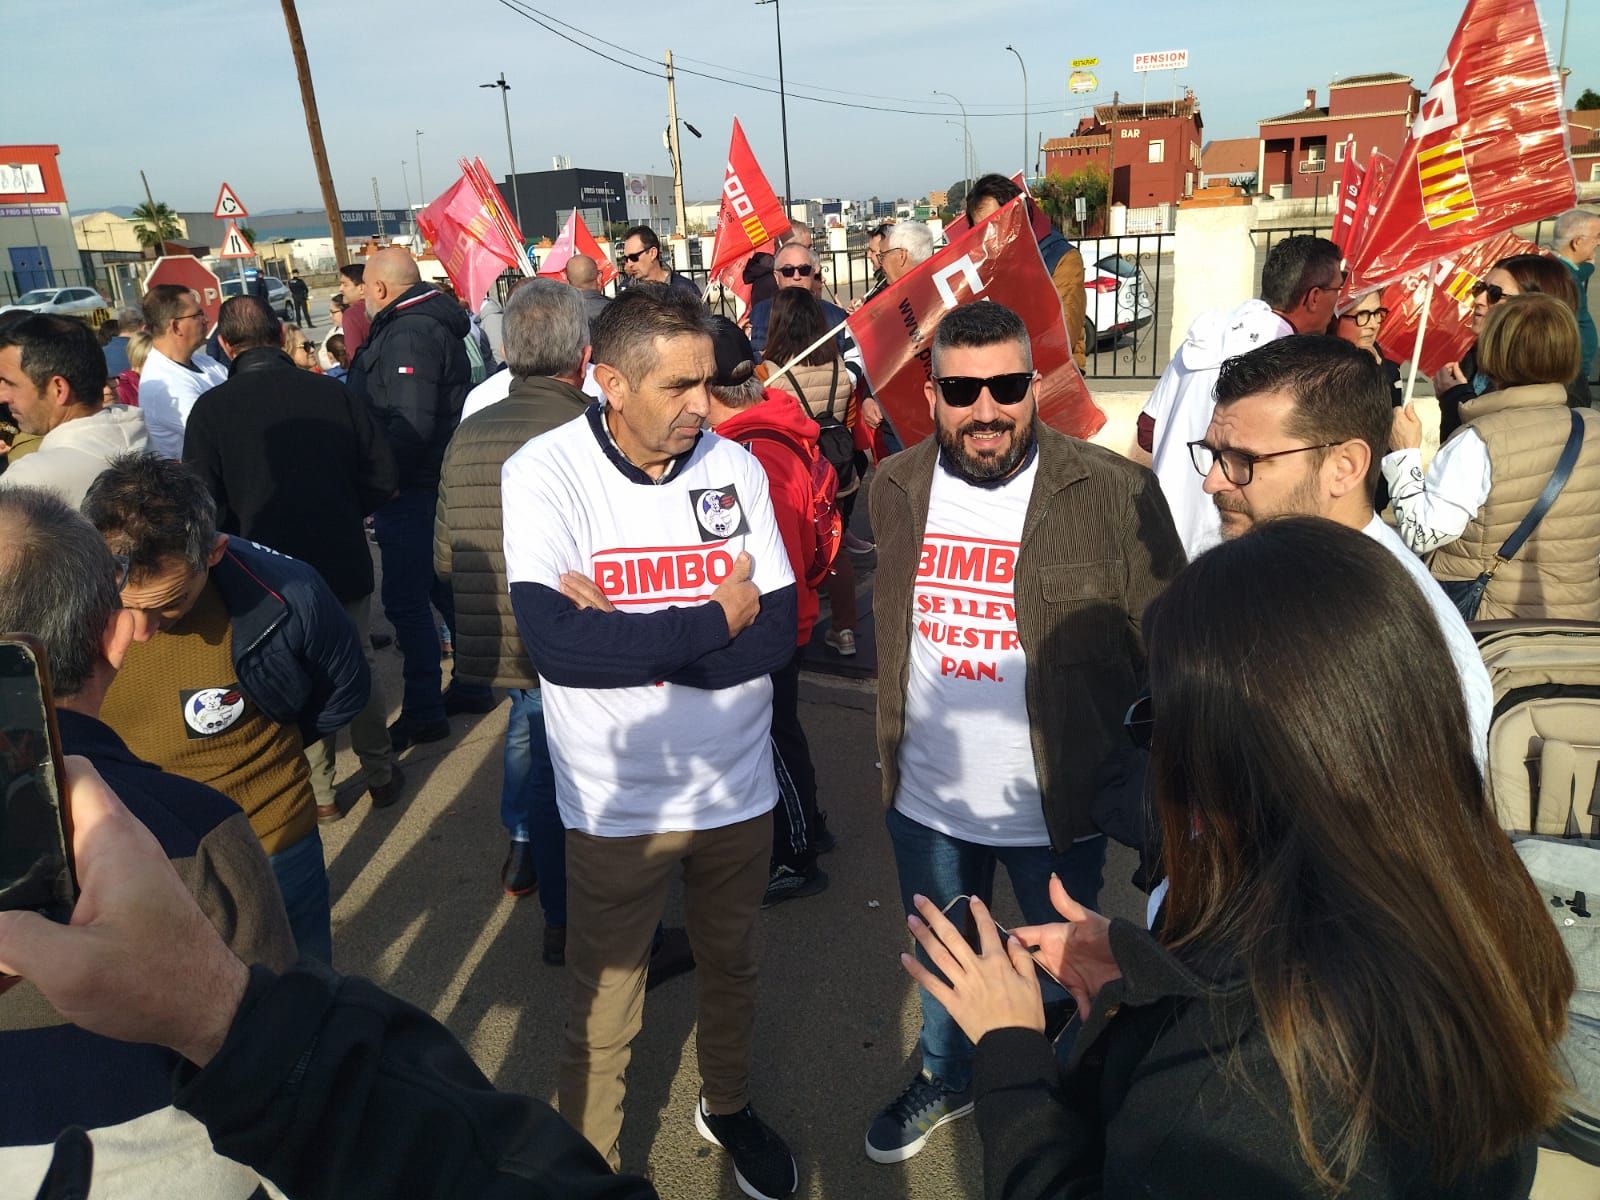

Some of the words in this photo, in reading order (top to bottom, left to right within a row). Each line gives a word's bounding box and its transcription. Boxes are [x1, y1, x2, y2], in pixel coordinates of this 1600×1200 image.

[1136, 52, 1185, 65] PENSION
[1121, 129, 1140, 138] BAR
[594, 551, 733, 595] BIMBO
[917, 544, 1015, 583] BIMB
[917, 594, 946, 613] SE
[952, 598, 1017, 621] LLEV
[918, 620, 1019, 650] NUESTR
[941, 656, 1003, 682] PAN.
